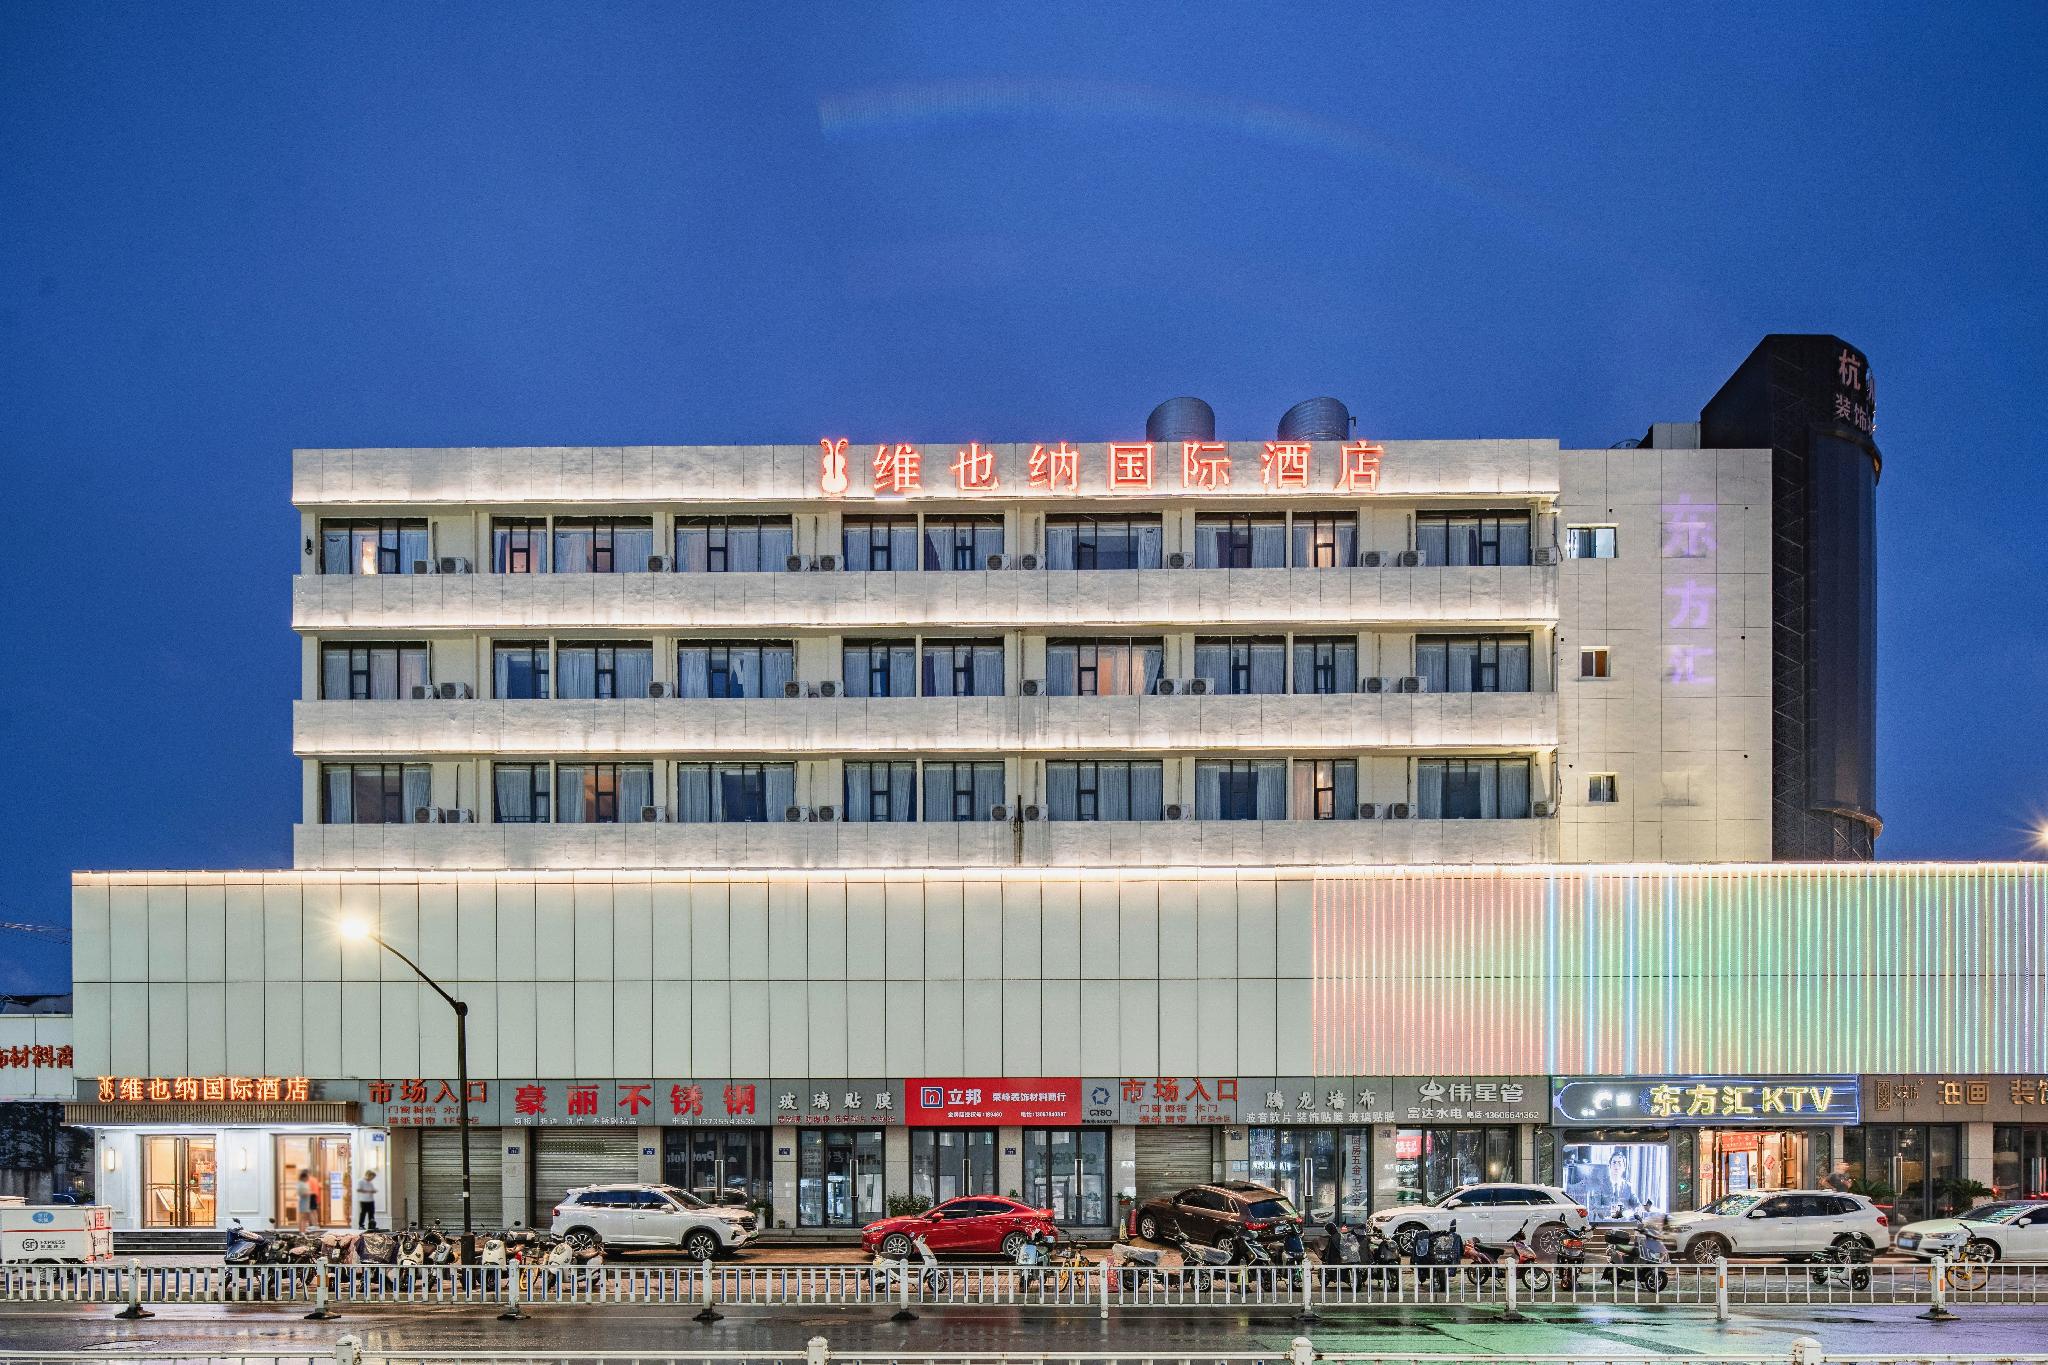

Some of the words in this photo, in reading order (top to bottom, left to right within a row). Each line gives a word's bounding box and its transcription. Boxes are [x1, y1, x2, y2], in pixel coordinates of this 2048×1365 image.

[872, 442, 1384, 492] 维也纳国际酒店
[119, 1077, 309, 1102] 维也纳国际酒店
[368, 1079, 487, 1105] 市场入口
[515, 1084, 757, 1117] 豪丽不锈钢
[778, 1091, 893, 1111] 玻璃贴膜
[947, 1089, 982, 1106] 立邦
[1121, 1078, 1238, 1103] 市场入口
[1265, 1089, 1376, 1110] 腾龙墙布
[1448, 1083, 1524, 1103] 伟星管
[1937, 1080, 1989, 1105] 油画
[1245, 1112, 1292, 1123] 波音软片
[1296, 1112, 1343, 1123] 装饰贴膜
[1348, 1112, 1396, 1123] 玻璃贴膜
[1407, 1107, 1463, 1119] 富达水电
